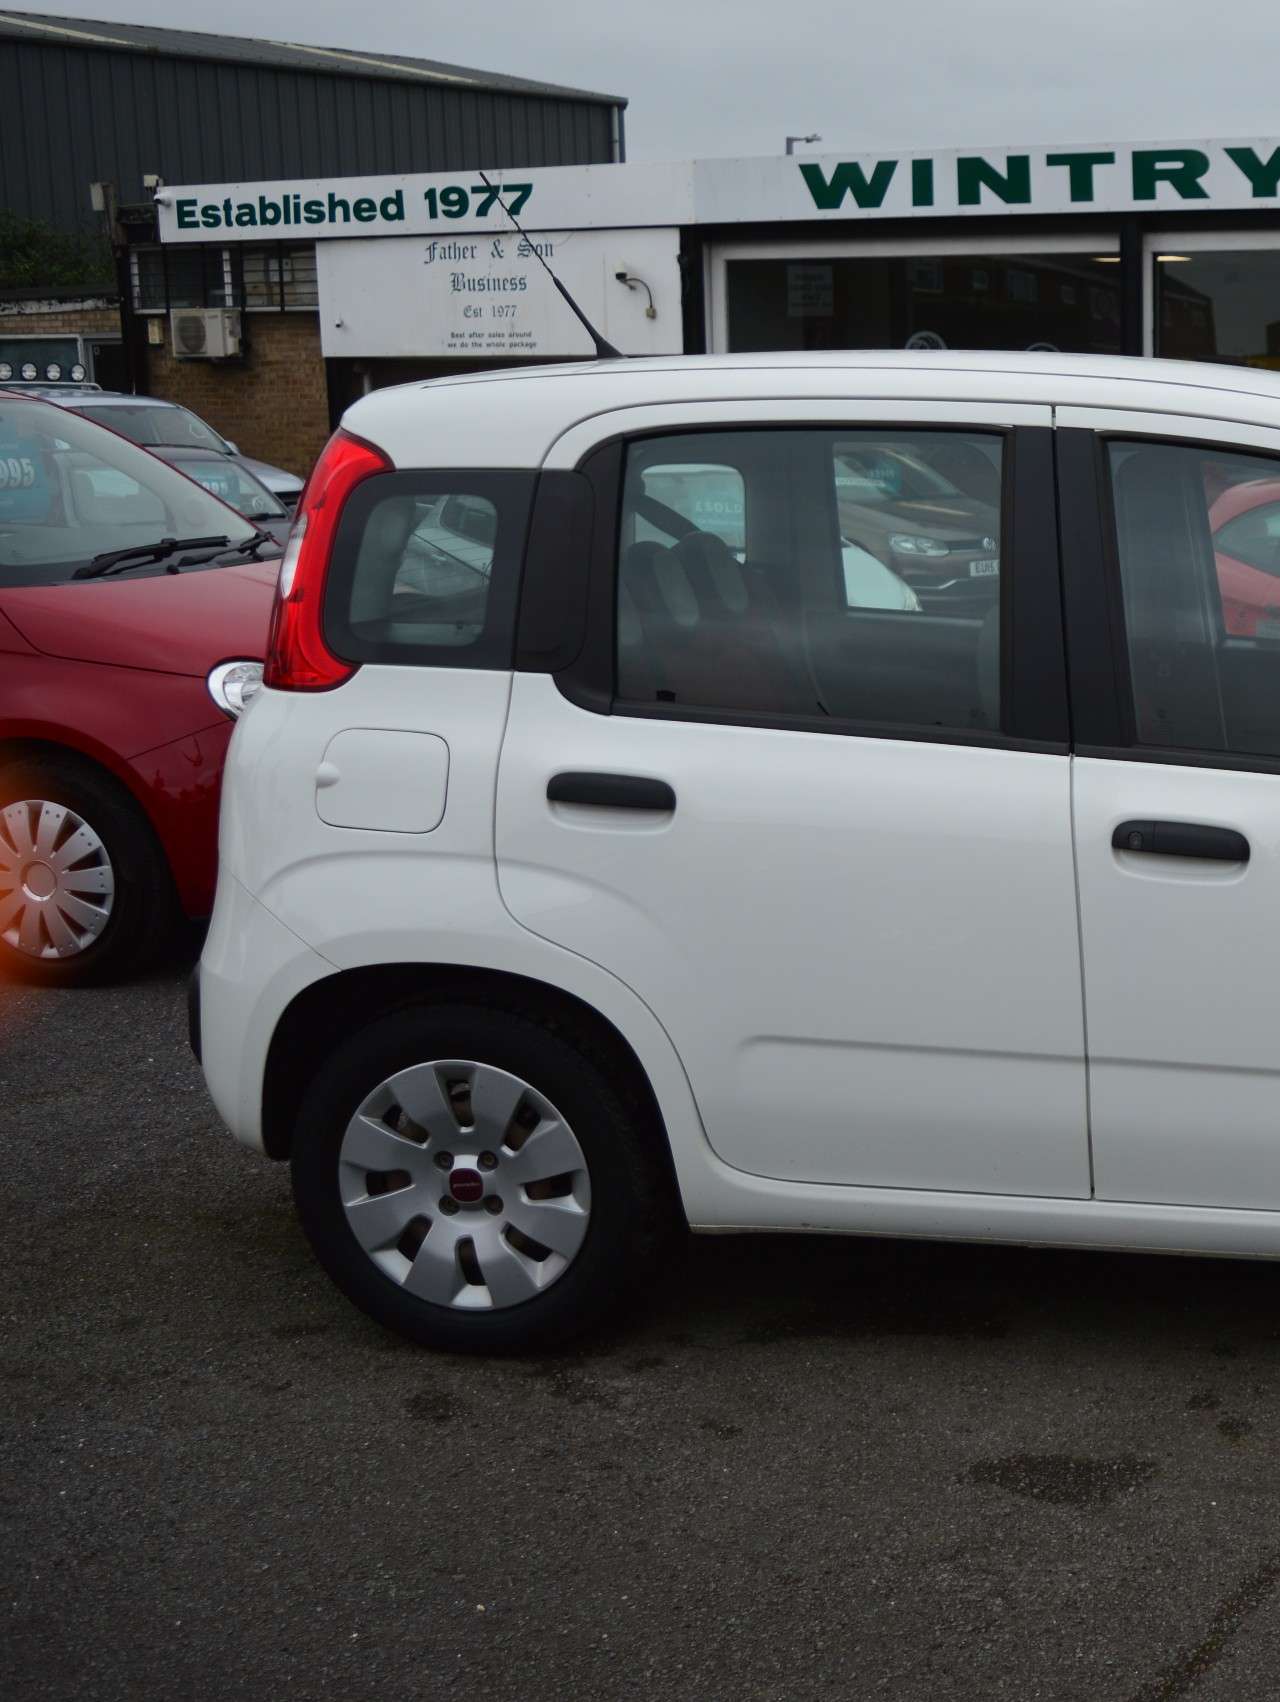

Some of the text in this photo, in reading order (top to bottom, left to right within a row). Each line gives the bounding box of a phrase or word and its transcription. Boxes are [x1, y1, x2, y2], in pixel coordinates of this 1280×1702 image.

[176, 183, 533, 229] Established 1977
[424, 238, 554, 264] Father & Son
[449, 271, 529, 294] Business
[463, 304, 518, 319] Est 1977
[451, 331, 466, 339] Best
[509, 331, 532, 339] around
[509, 341, 537, 350] package
